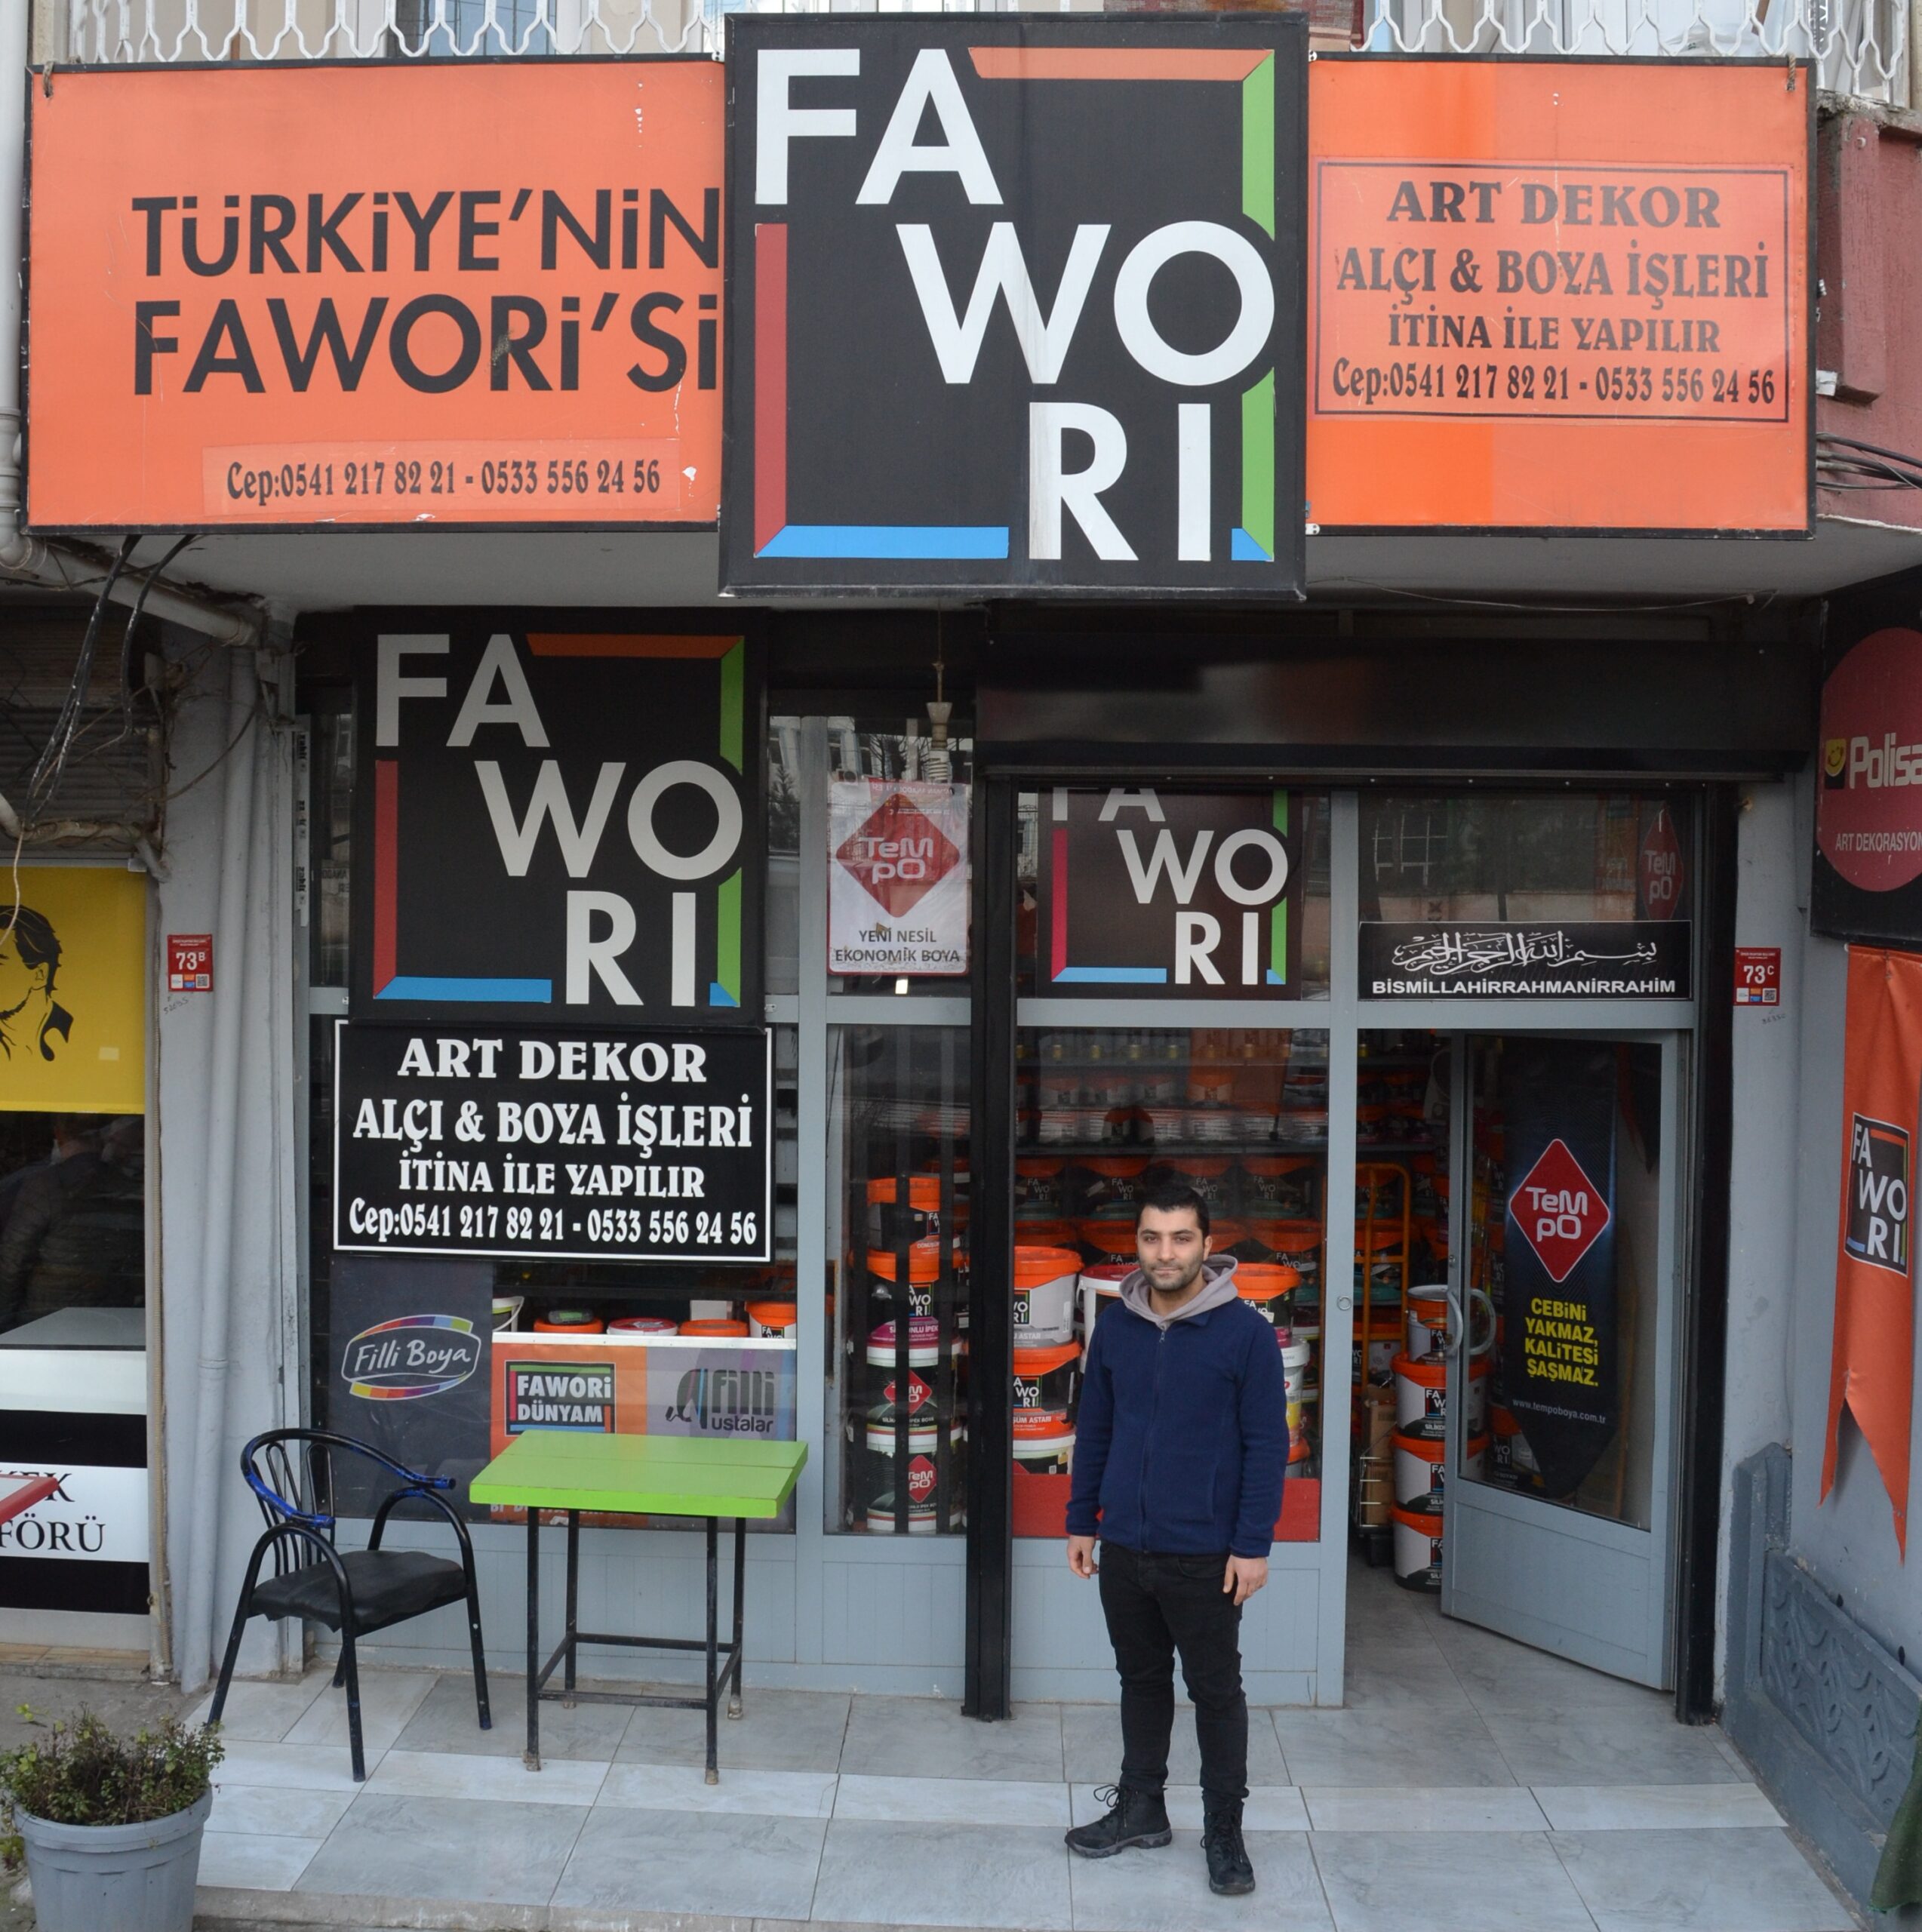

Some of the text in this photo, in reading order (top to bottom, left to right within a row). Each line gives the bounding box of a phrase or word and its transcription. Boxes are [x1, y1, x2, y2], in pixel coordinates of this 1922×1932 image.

[755, 48, 1004, 205] FA
[1386, 180, 1721, 228] ART DEKOR
[1336, 239, 1769, 310] ALÇI & BOYA İŞLERİ
[896, 220, 1275, 386] WO
[1388, 304, 1721, 352] İTİNA İLE YAPILIR
[1333, 357, 1445, 404] Cep:0541
[1456, 365, 1497, 399] 217
[1507, 365, 1536, 399] 82
[1544, 367, 1570, 400] 21
[1595, 367, 1653, 401] 0533
[1661, 368, 1705, 402] 556
[1712, 368, 1740, 403] 24
[1748, 369, 1775, 404] 56
[227, 462, 334, 506] Cep:0541
[345, 463, 384, 495] 217
[393, 463, 423, 495] 82
[429, 463, 456, 495] 21
[481, 462, 539, 494] 0533
[547, 461, 590, 494] 556
[598, 460, 626, 494] 24
[634, 460, 662, 494] 56
[1029, 401, 1210, 561] RI
[376, 634, 550, 747] FA
[474, 760, 743, 881] WO
[1835, 833, 1854, 851] ART
[1116, 829, 1288, 905] WO
[566, 891, 696, 1007] RI
[1175, 911, 1259, 985] RI
[397, 1038, 706, 1083] ART DEKOR
[352, 1091, 752, 1158] ALÇI & BOYA İŞLERİ
[1852, 1123, 1871, 1168] FA
[398, 1150, 705, 1198] İTİNA İLE YAPILIR
[1859, 1169, 1907, 1221] WO
[349, 1197, 451, 1242] Cep:0541
[460, 1205, 498, 1238] 217
[506, 1206, 533, 1239] 82
[539, 1208, 564, 1241] 21
[587, 1209, 641, 1242] 0533
[648, 1210, 689, 1243] 556
[696, 1211, 722, 1244] 24
[730, 1211, 757, 1244] 56
[1867, 1216, 1900, 1263] RI
[354, 1340, 471, 1374] Filli Boya
[518, 1400, 603, 1423] DÜNYAM
[1015, 1386, 1039, 1398] WO
[1023, 1398, 1035, 1407] RI
[712, 1416, 773, 1433] ustalar
